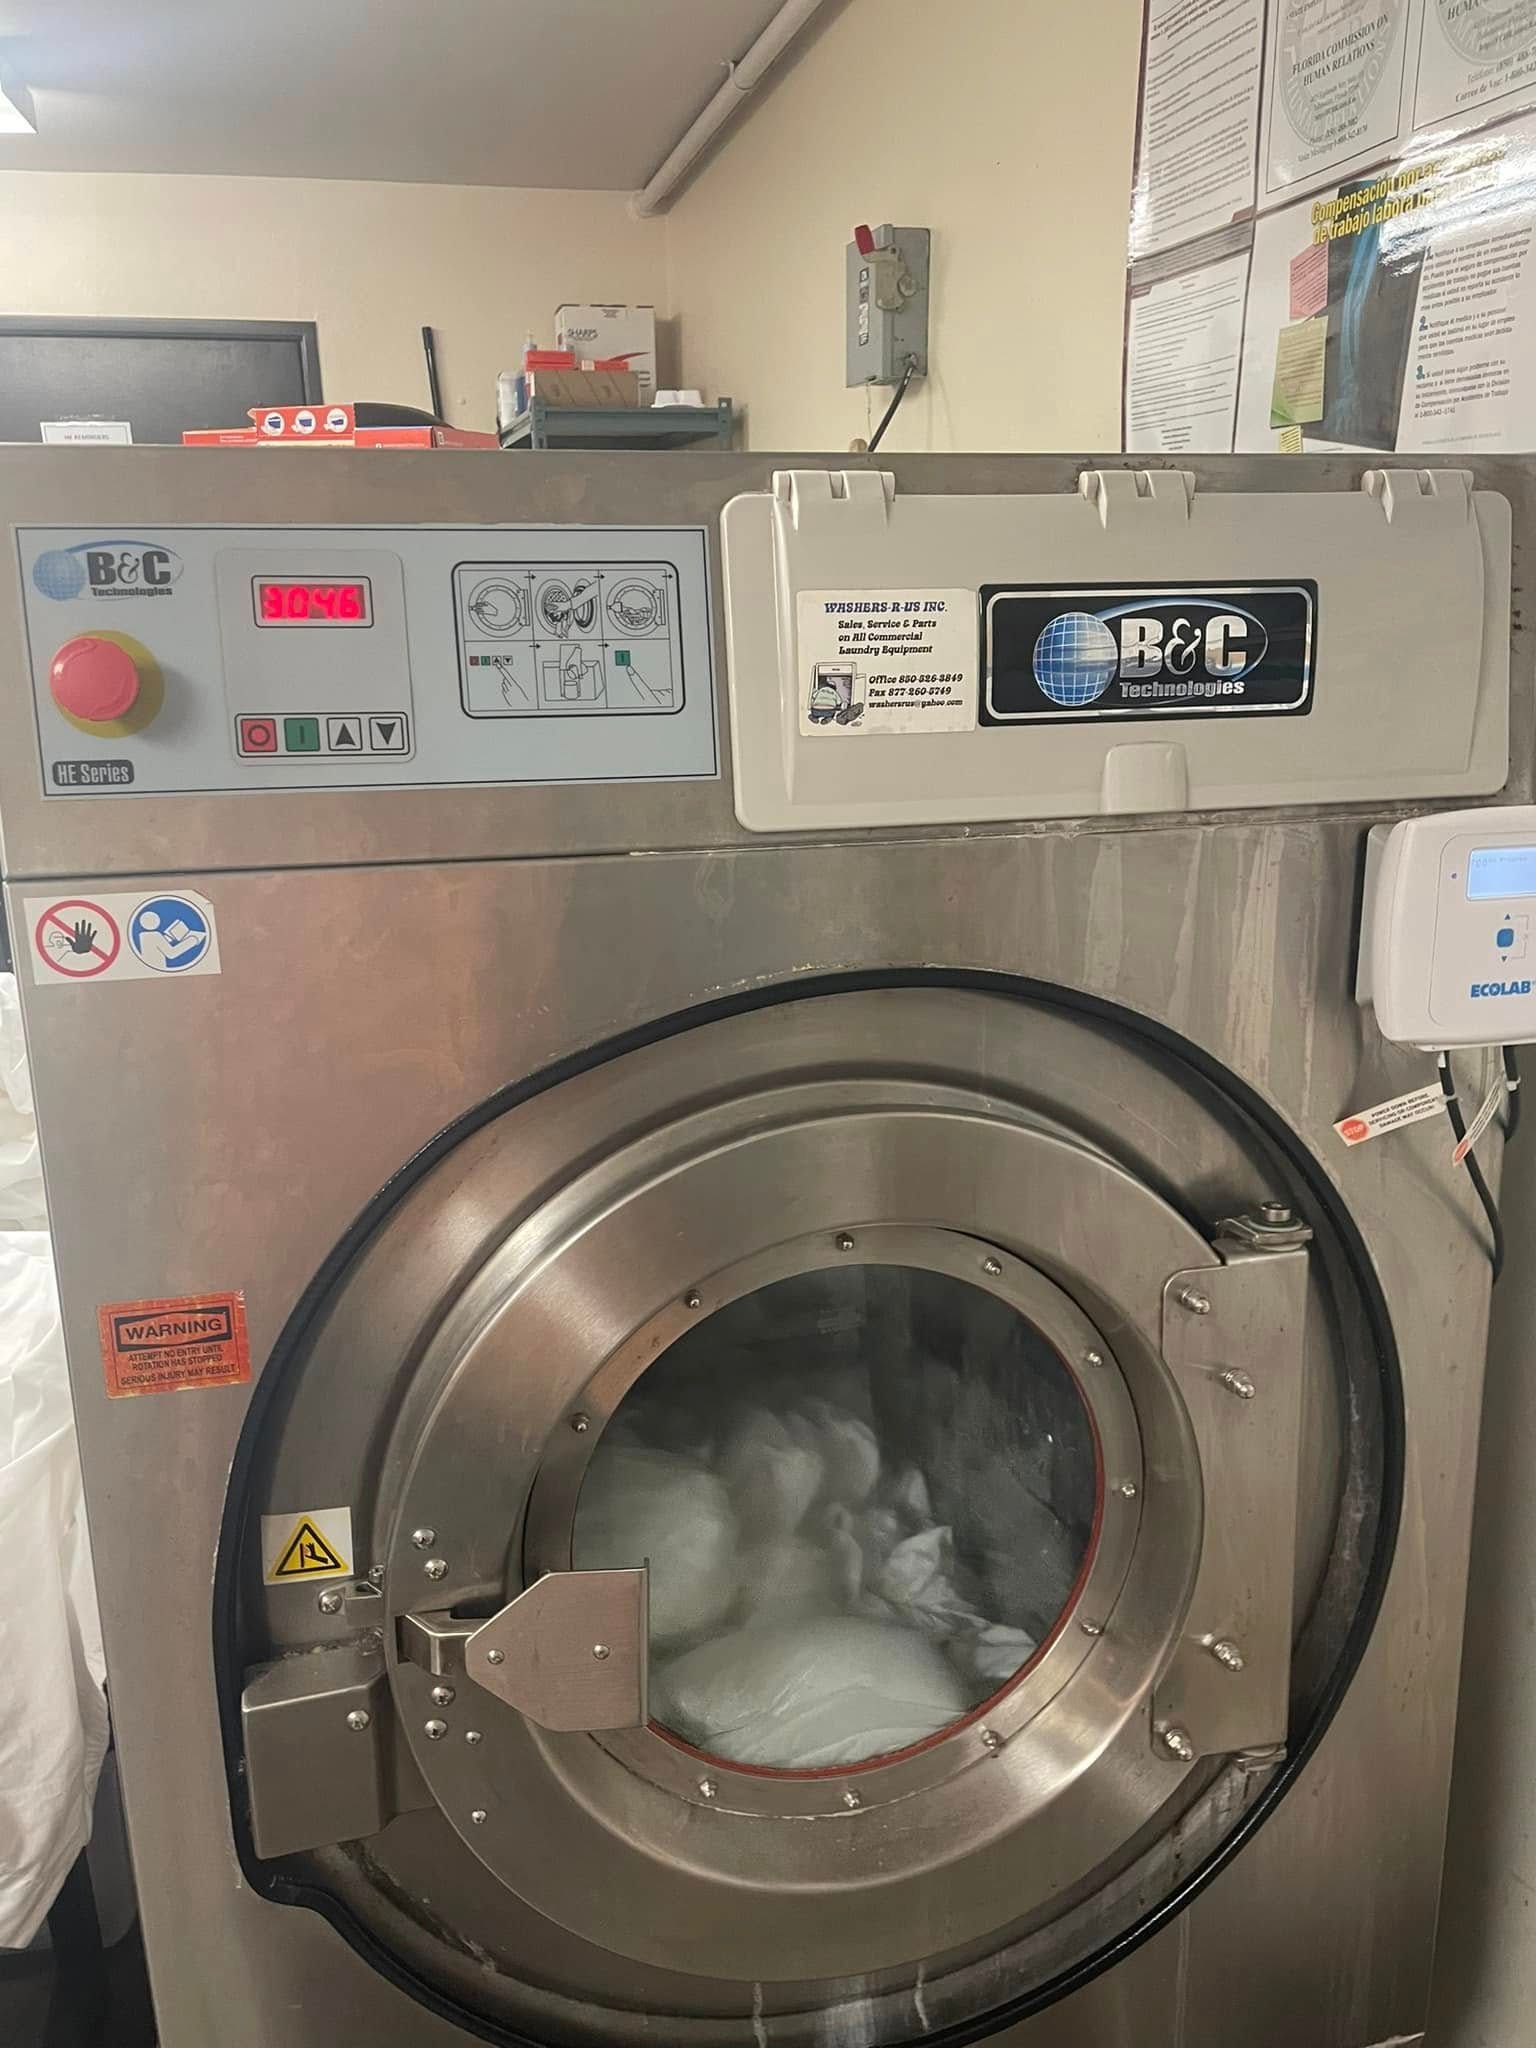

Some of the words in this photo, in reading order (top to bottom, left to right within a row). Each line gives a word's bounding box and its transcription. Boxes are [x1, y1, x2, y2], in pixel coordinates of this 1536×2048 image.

[1292, 50, 1326, 76] FLORIDA
[1327, 23, 1376, 58] COMMISSION
[1377, 13, 1389, 29] ON
[1303, 65, 1331, 86] HUMAN
[1332, 40, 1377, 71] RELATIONS
[1312, 172, 1395, 225] Compensación
[1313, 224, 1328, 246] de
[1327, 210, 1370, 240] trabajo
[87, 550, 171, 585] B&C
[90, 586, 173, 597] Technologies
[824, 601, 921, 614] WASHERS-R-US
[923, 601, 948, 613] INC.
[838, 619, 865, 630] Sales,
[867, 619, 901, 629] Service
[902, 619, 911, 628] &
[911, 618, 937, 629] Parts
[838, 634, 850, 642] on
[852, 632, 866, 642] All
[868, 632, 923, 642] Commercial
[1120, 615, 1248, 678] B&C
[838, 645, 880, 657] Laundry
[881, 645, 933, 656] Equipment
[868, 675, 898, 685] Office
[1120, 680, 1245, 699] Technologies
[868, 688, 886, 697] Fax
[57, 764, 77, 784] HE
[80, 762, 130, 784] Series
[1470, 980, 1532, 998] ECOLAB
[1371, 1105, 1391, 1118] POWER
[1390, 1100, 1407, 1111] DOWN
[1407, 1093, 1429, 1105] BEFORE
[1368, 1111, 1397, 1126] SERVICING
[1397, 1107, 1405, 1115] OR
[1343, 1123, 1365, 1137] STOP
[125, 1318, 222, 1341] WARNING
[128, 1350, 163, 1363] ATTEMPT
[164, 1349, 176, 1359] NO
[177, 1346, 201, 1357] ENTRY
[202, 1344, 224, 1354] UNTIL
[132, 1359, 170, 1371] ROTATION
[171, 1357, 186, 1367] HAS
[187, 1354, 223, 1365] STOPPED
[120, 1373, 157, 1386] SERIOUS
[158, 1370, 186, 1381] INJURY
[187, 1367, 204, 1377] MAY
[205, 1363, 236, 1375] RESULT
